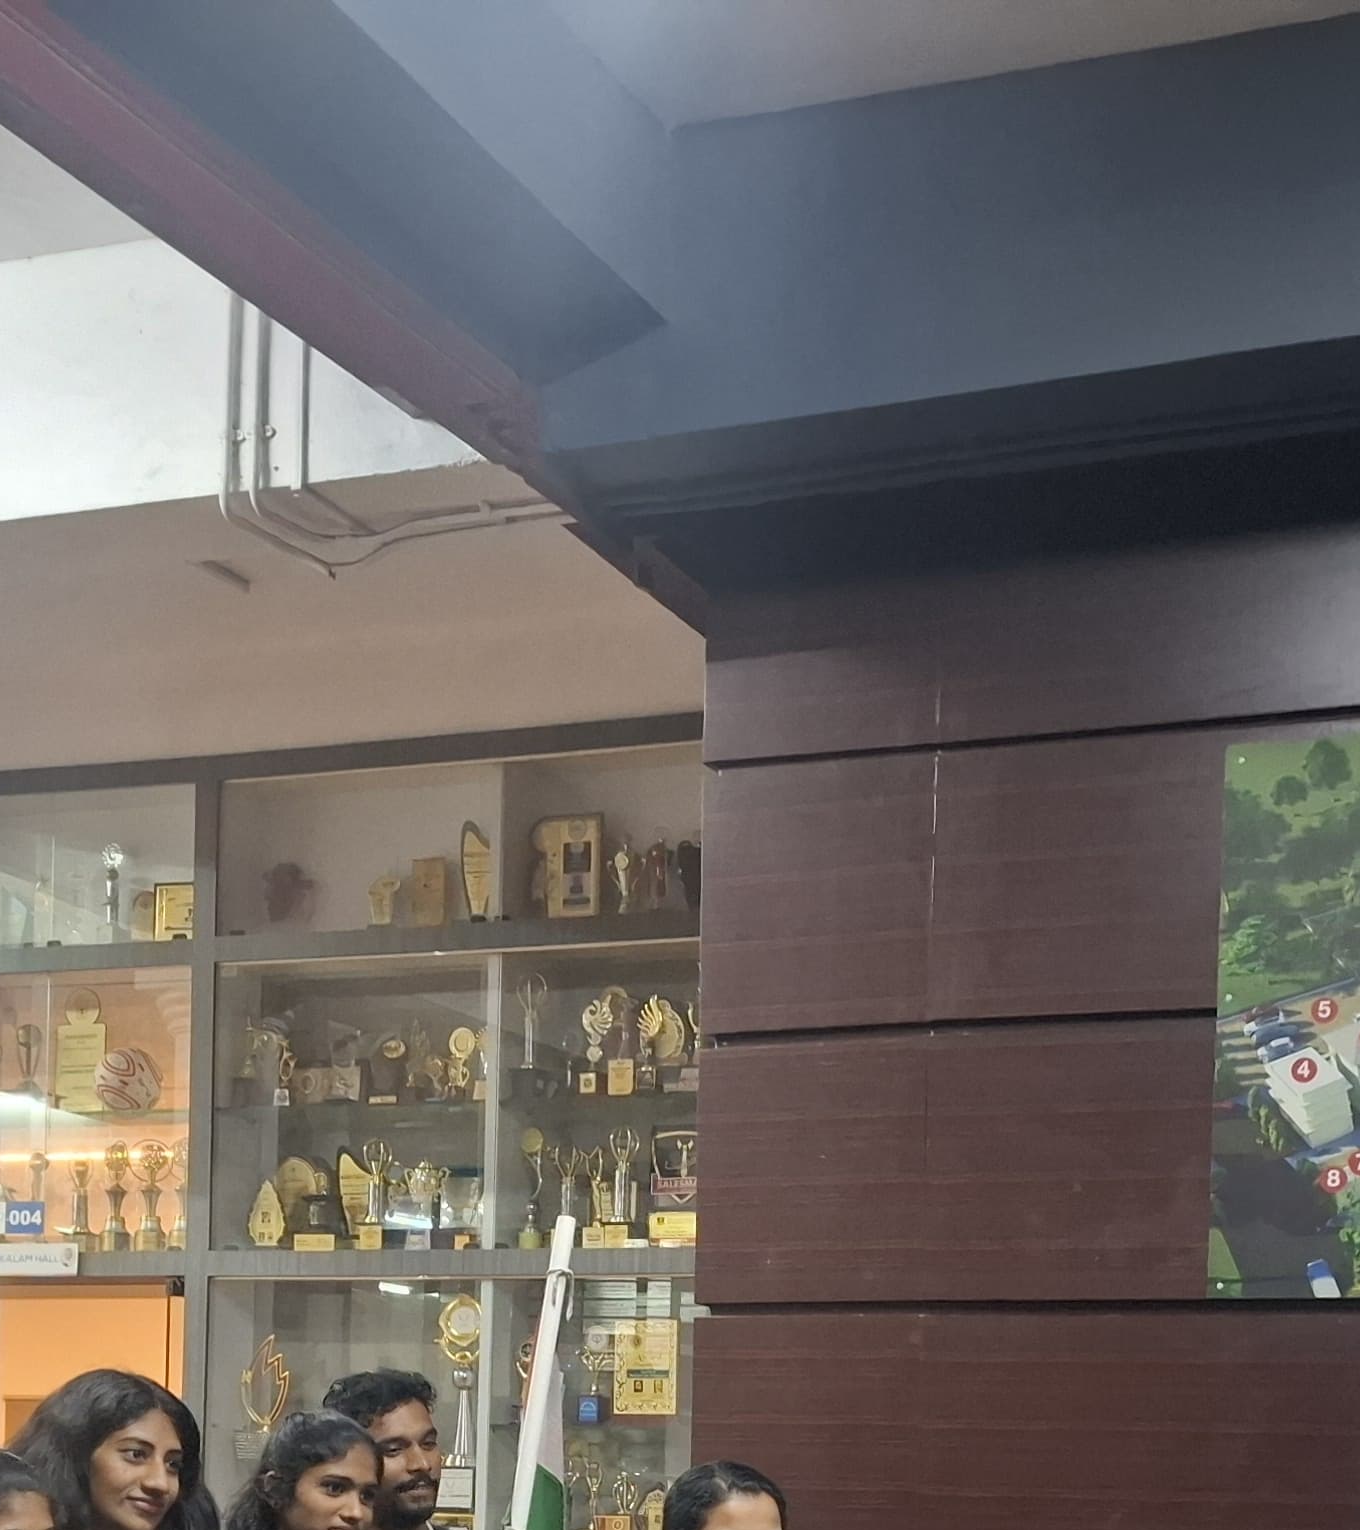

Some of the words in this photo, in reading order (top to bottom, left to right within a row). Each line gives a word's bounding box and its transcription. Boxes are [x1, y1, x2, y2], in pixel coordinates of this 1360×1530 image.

[1318, 1001, 1330, 1017] 5
[1297, 1061, 1312, 1079] 4
[1327, 1170, 1340, 1186] 8
